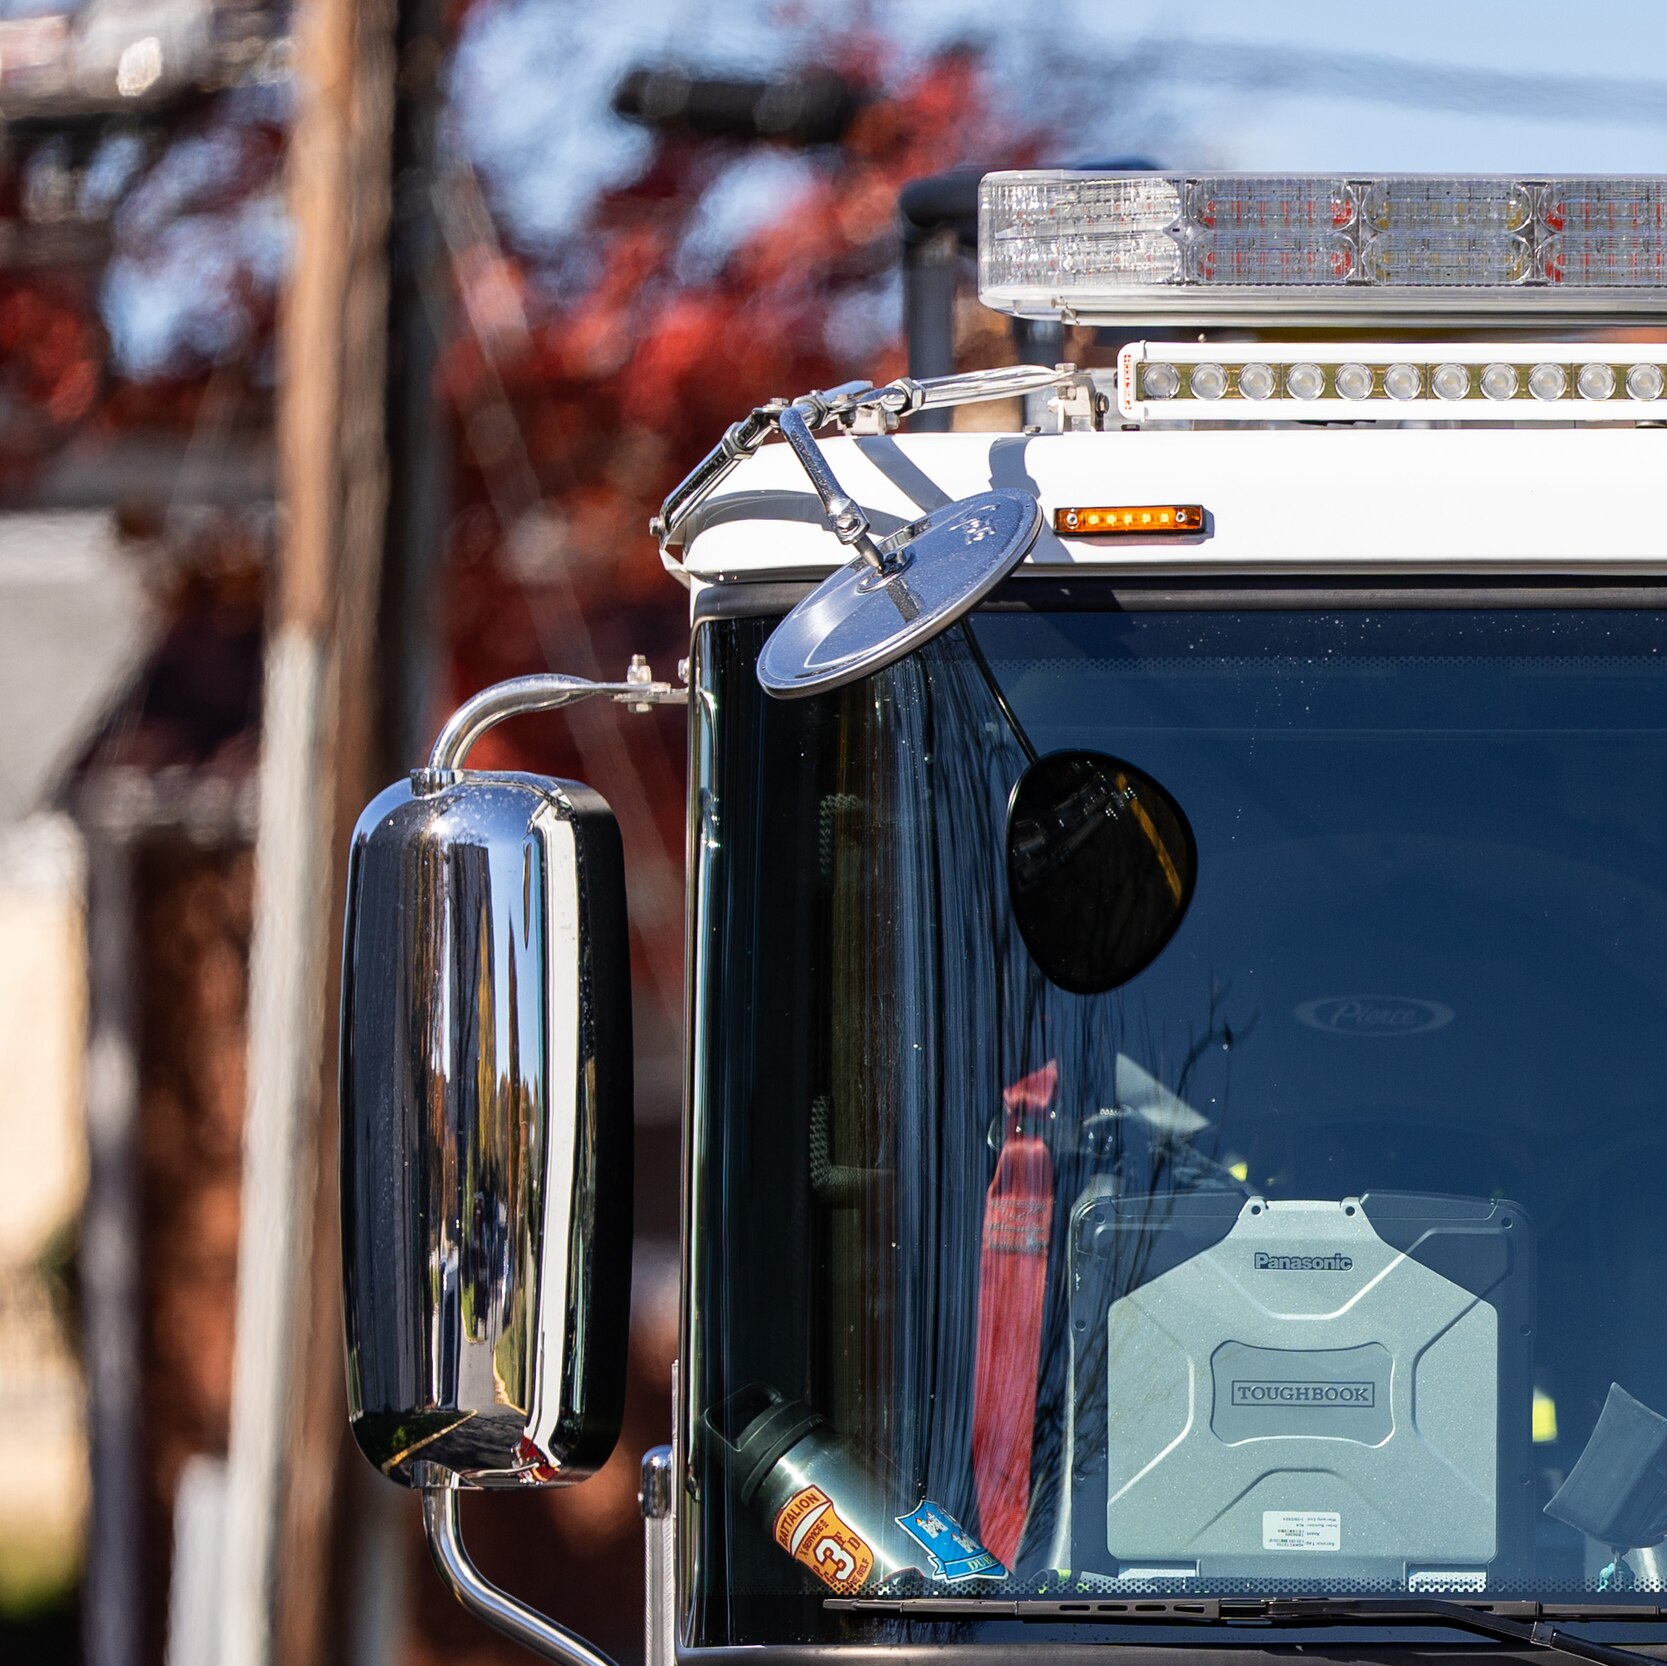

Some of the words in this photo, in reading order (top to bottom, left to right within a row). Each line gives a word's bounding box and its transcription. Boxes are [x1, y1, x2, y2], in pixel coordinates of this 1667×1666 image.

[1254, 1252, 1353, 1271] Panasonic
[1237, 1386, 1369, 1402] TOUGHBOOK
[778, 1491, 821, 1546] BATTALION
[801, 1522, 825, 1553] SERVICE
[814, 1536, 857, 1581] 3
